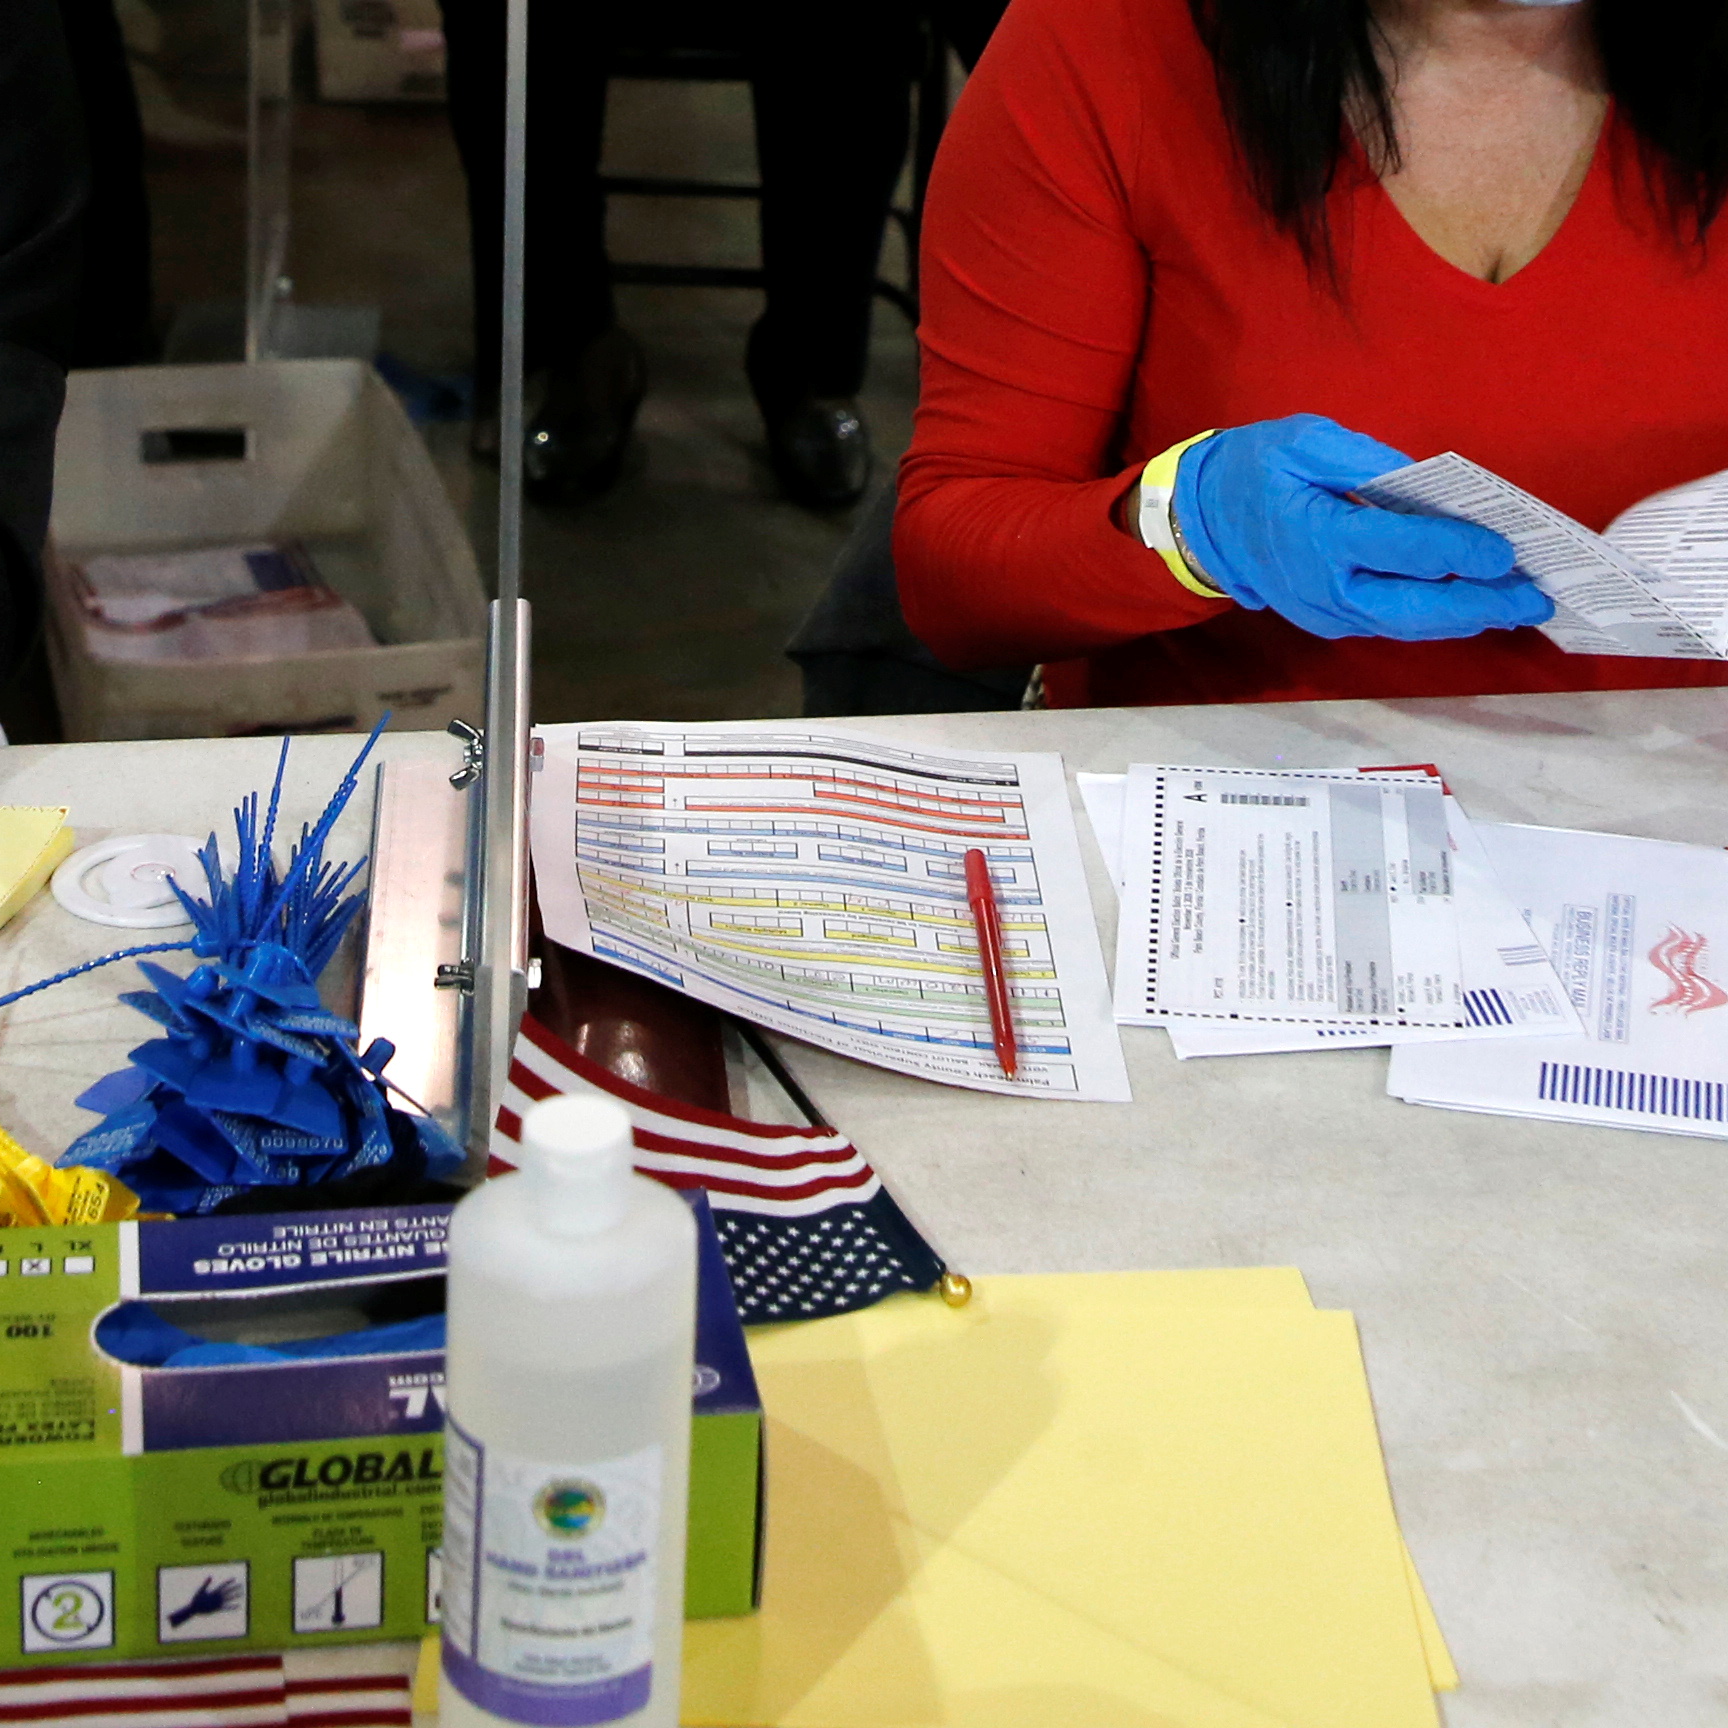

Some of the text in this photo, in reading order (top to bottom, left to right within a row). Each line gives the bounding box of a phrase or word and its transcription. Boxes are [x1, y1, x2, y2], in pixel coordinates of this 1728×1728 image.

[1575, 911, 1594, 956] BUSINESS
[273, 1215, 450, 1240] ANTS EN NITRILE
[30, 1242, 44, 1253] L
[66, 1240, 93, 1253] XL
[218, 1239, 303, 1257] NITRILO
[310, 1243, 415, 1266] NITRILE
[193, 1254, 302, 1275] GLOVES
[6, 1324, 55, 1340] 100
[259, 1448, 443, 1491] GLOBAL
